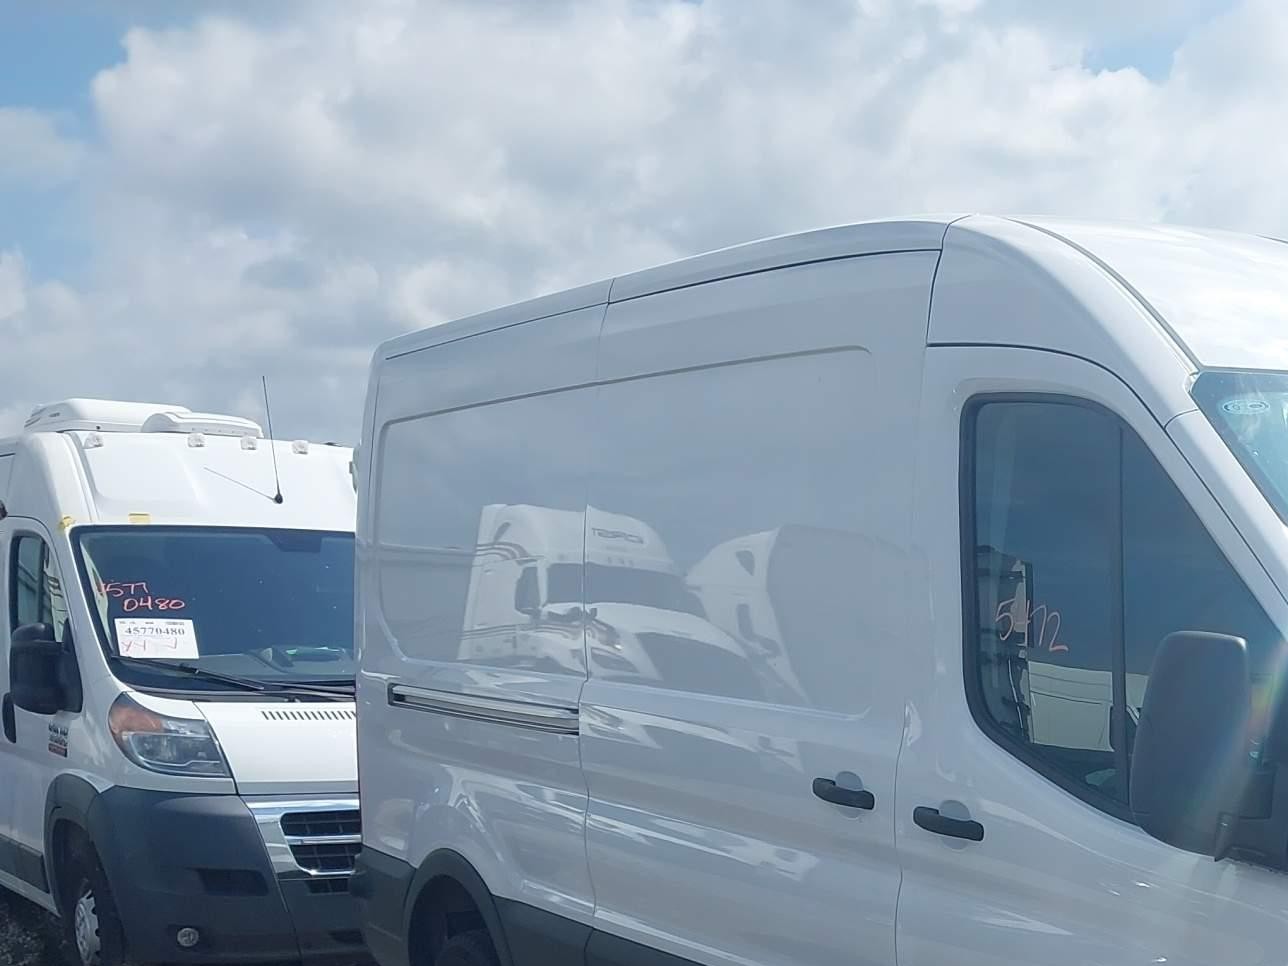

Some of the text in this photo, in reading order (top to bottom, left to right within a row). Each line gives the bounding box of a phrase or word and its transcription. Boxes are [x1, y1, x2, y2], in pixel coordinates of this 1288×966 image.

[123, 596, 186, 612] 0480
[124, 626, 186, 636] 45770480
[994, 599, 1069, 652] 5472
